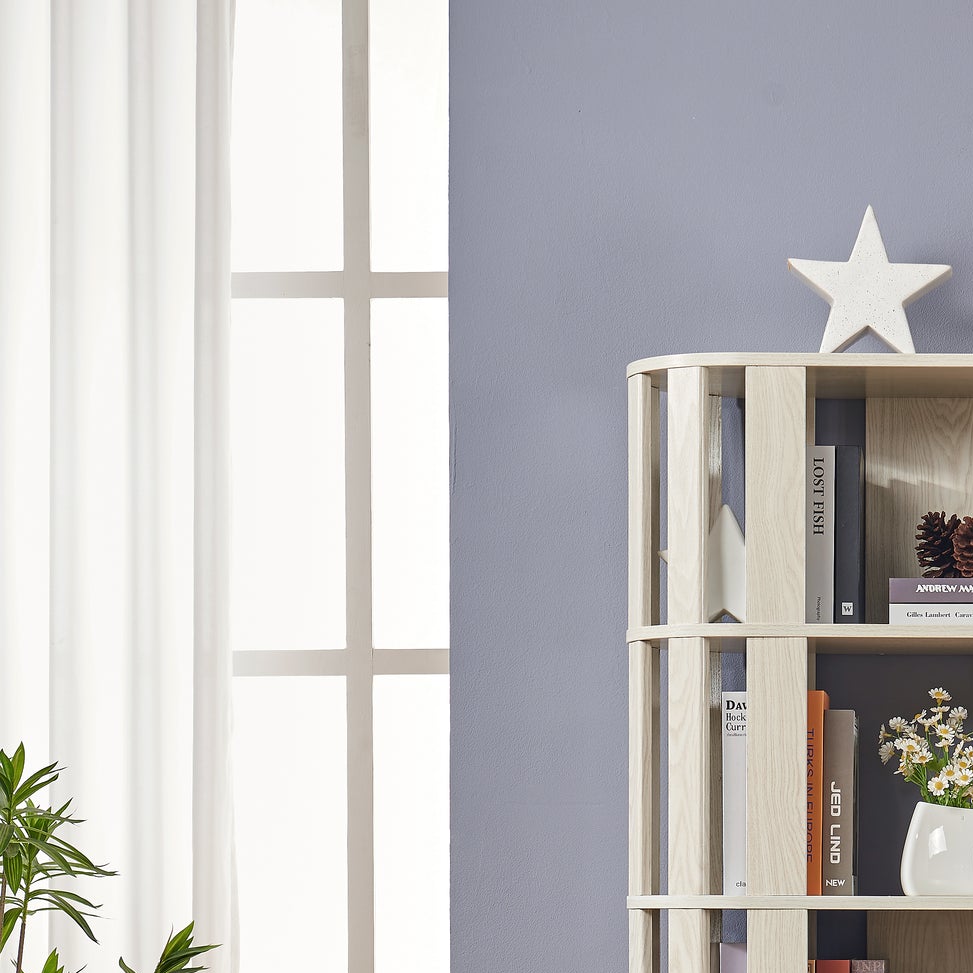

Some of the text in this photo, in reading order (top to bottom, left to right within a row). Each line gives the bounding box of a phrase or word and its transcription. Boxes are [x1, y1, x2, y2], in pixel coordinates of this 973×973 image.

[813, 458, 824, 535] LOST FISH
[916, 584, 958, 593] ANDREW
[726, 712, 746, 721] Hock
[726, 722, 746, 731] Curr
[830, 781, 840, 863] JED LIND
